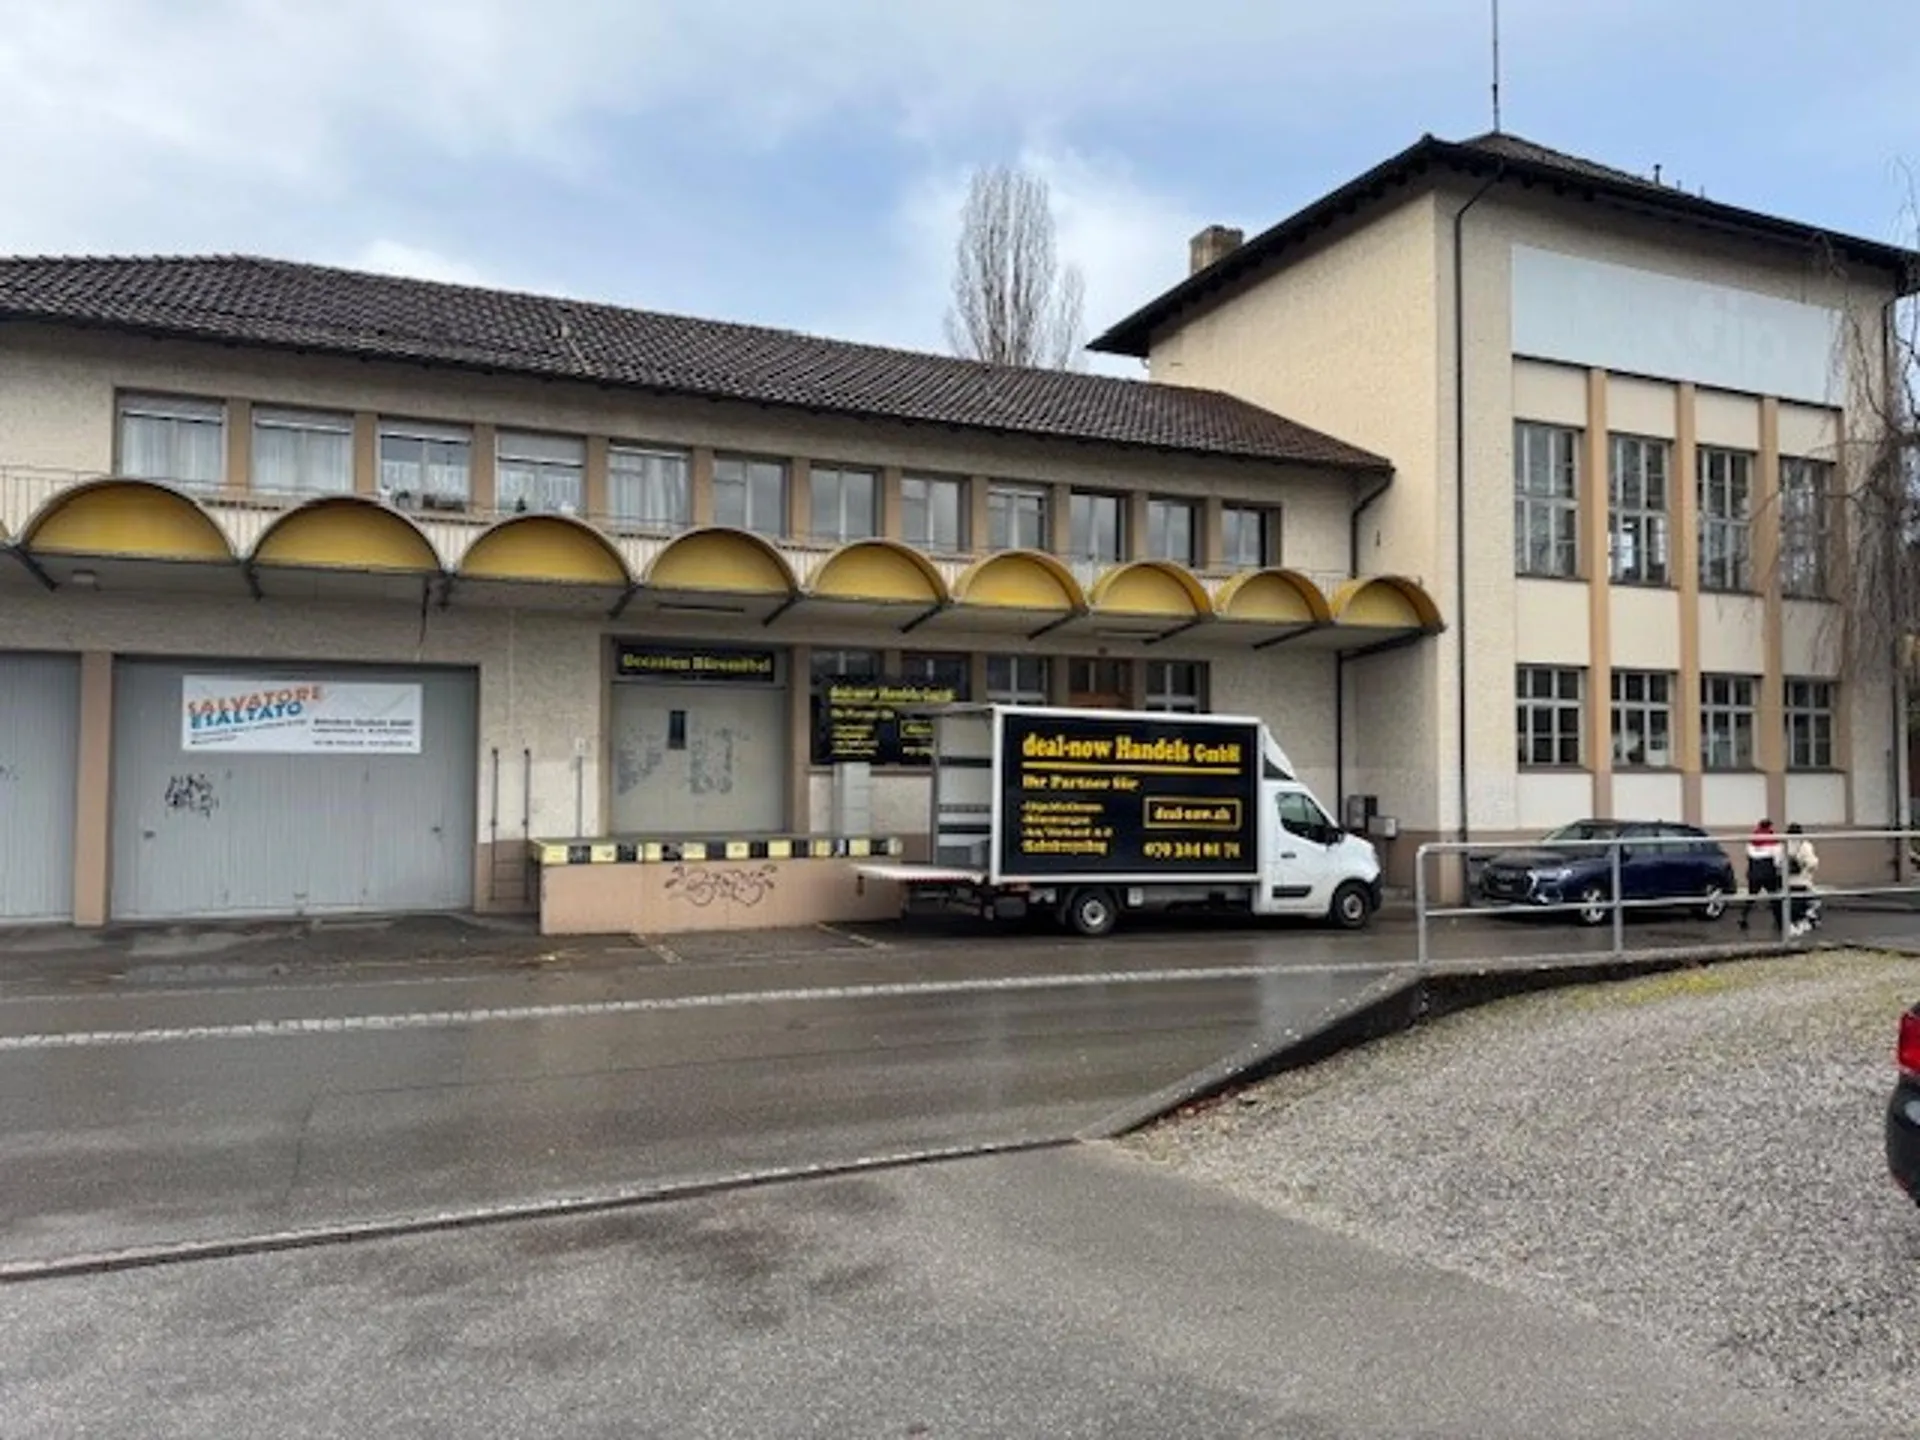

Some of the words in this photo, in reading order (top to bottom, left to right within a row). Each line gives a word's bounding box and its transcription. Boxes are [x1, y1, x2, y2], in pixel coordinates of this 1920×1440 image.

[188, 685, 321, 714] SALVATORE
[1022, 731, 1112, 757] deal-now
[1115, 735, 1190, 762] Handels
[1194, 744, 1240, 763] GmbH
[1050, 776, 1109, 790] Partner
